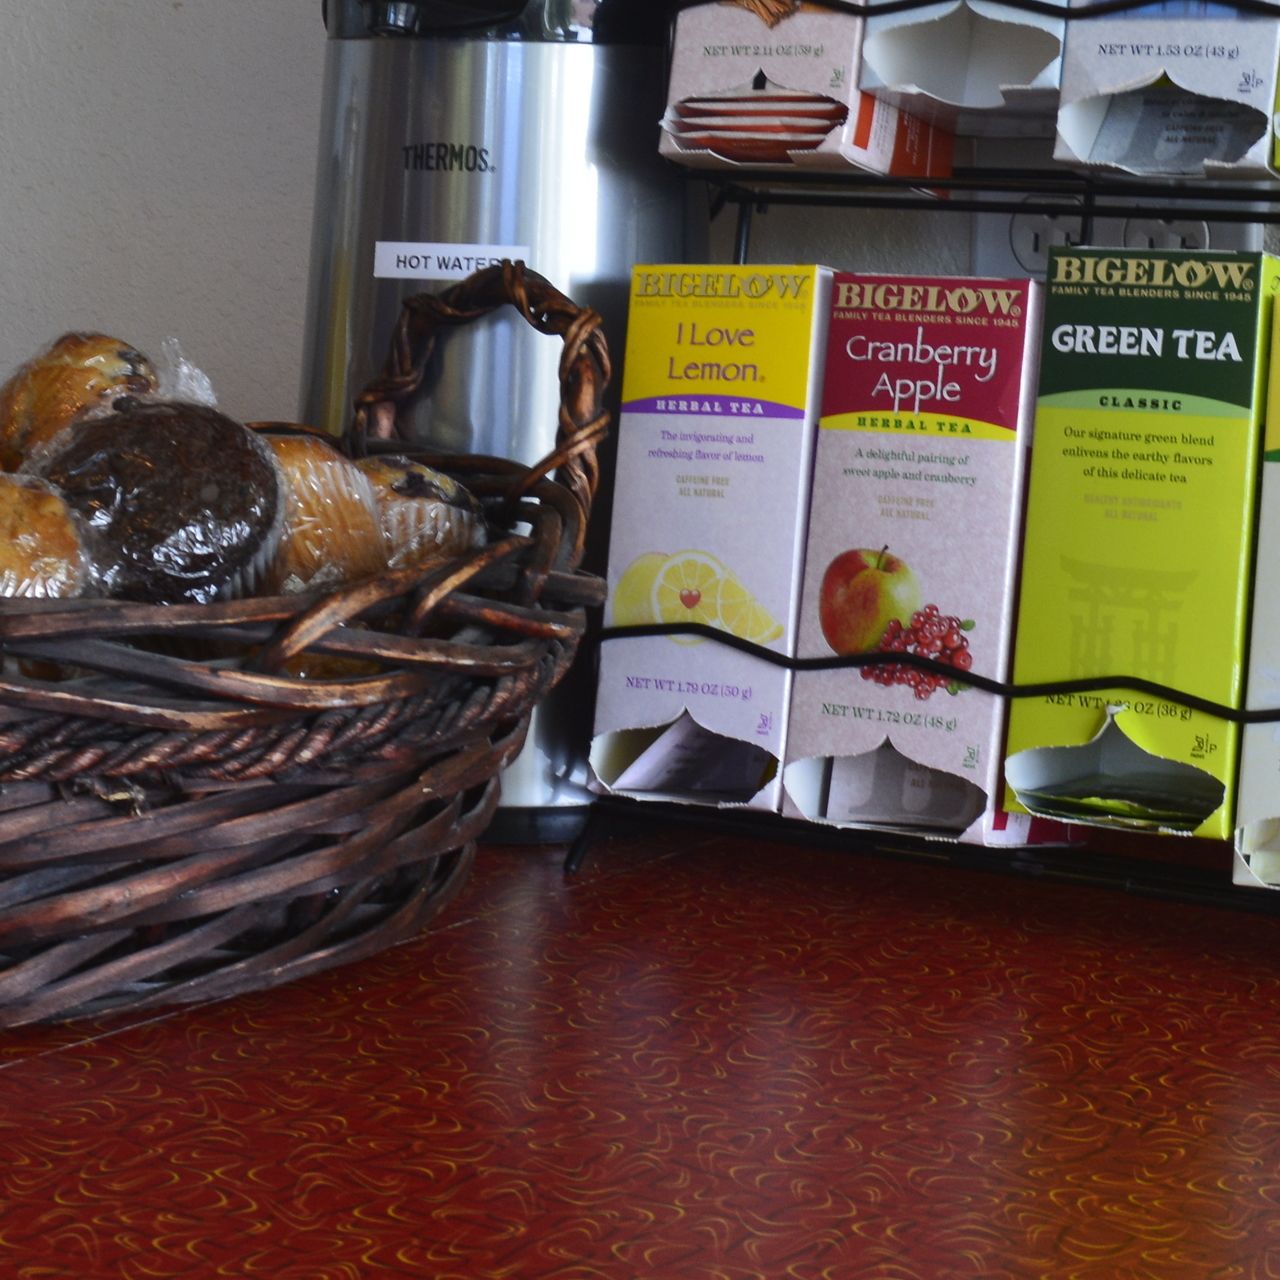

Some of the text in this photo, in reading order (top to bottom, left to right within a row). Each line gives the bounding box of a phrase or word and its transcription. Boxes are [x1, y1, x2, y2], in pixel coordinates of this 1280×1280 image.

[396, 255, 431, 269] HOT
[1052, 286, 1251, 302] FAMILY TEA BLENDERS SINCE 1945
[872, 313, 891, 321] TEA
[896, 313, 951, 324] BLENDERS
[956, 317, 988, 326] SINCE
[993, 319, 1019, 328] 1945
[677, 323, 754, 347] I Love
[1052, 324, 1243, 362] GREEN TEA
[847, 326, 997, 382] Cranberry
[668, 357, 758, 382] Lemon
[872, 363, 961, 414] Apple
[657, 400, 763, 414] HERBAL TEA
[1100, 396, 1182, 410] CLASSIC
[858, 417, 971, 433] HERBAL TEA
[1064, 426, 1214, 446] Our signature green blend
[1062, 447, 1213, 465] enlivens the earthy flavors
[1083, 466, 1187, 483] of this delicate tea
